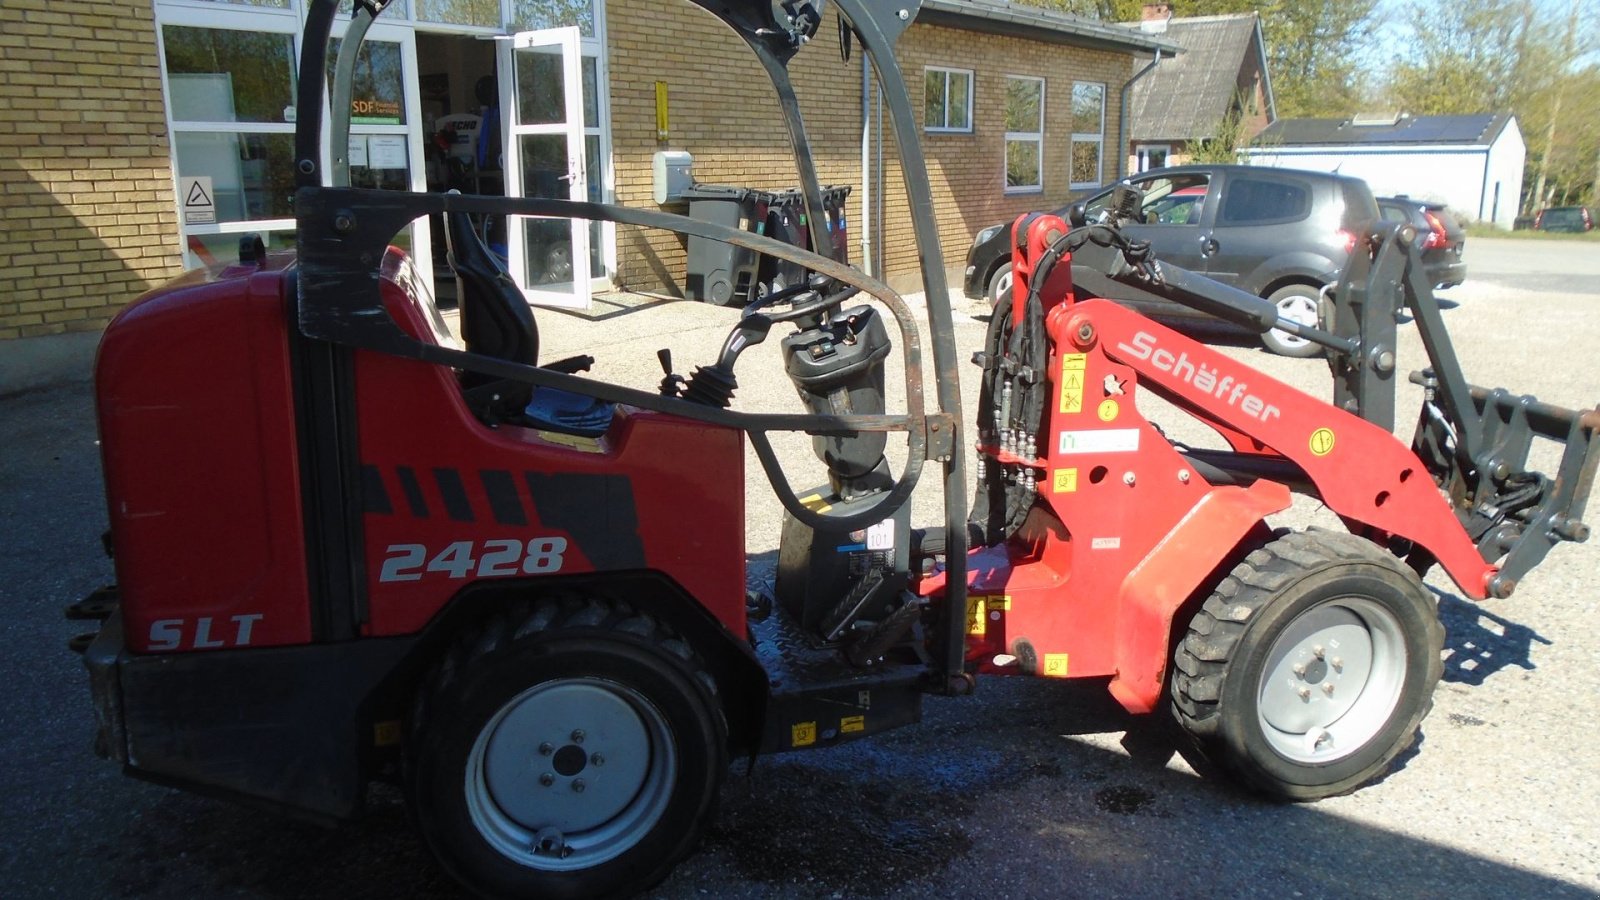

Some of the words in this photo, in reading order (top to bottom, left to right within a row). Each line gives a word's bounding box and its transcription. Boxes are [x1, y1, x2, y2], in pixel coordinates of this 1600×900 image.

[352, 100, 373, 113] SDF
[452, 120, 477, 130] ECHO
[1117, 331, 1280, 422] Schäffer
[871, 533, 887, 547] 101
[379, 536, 568, 583] 2428
